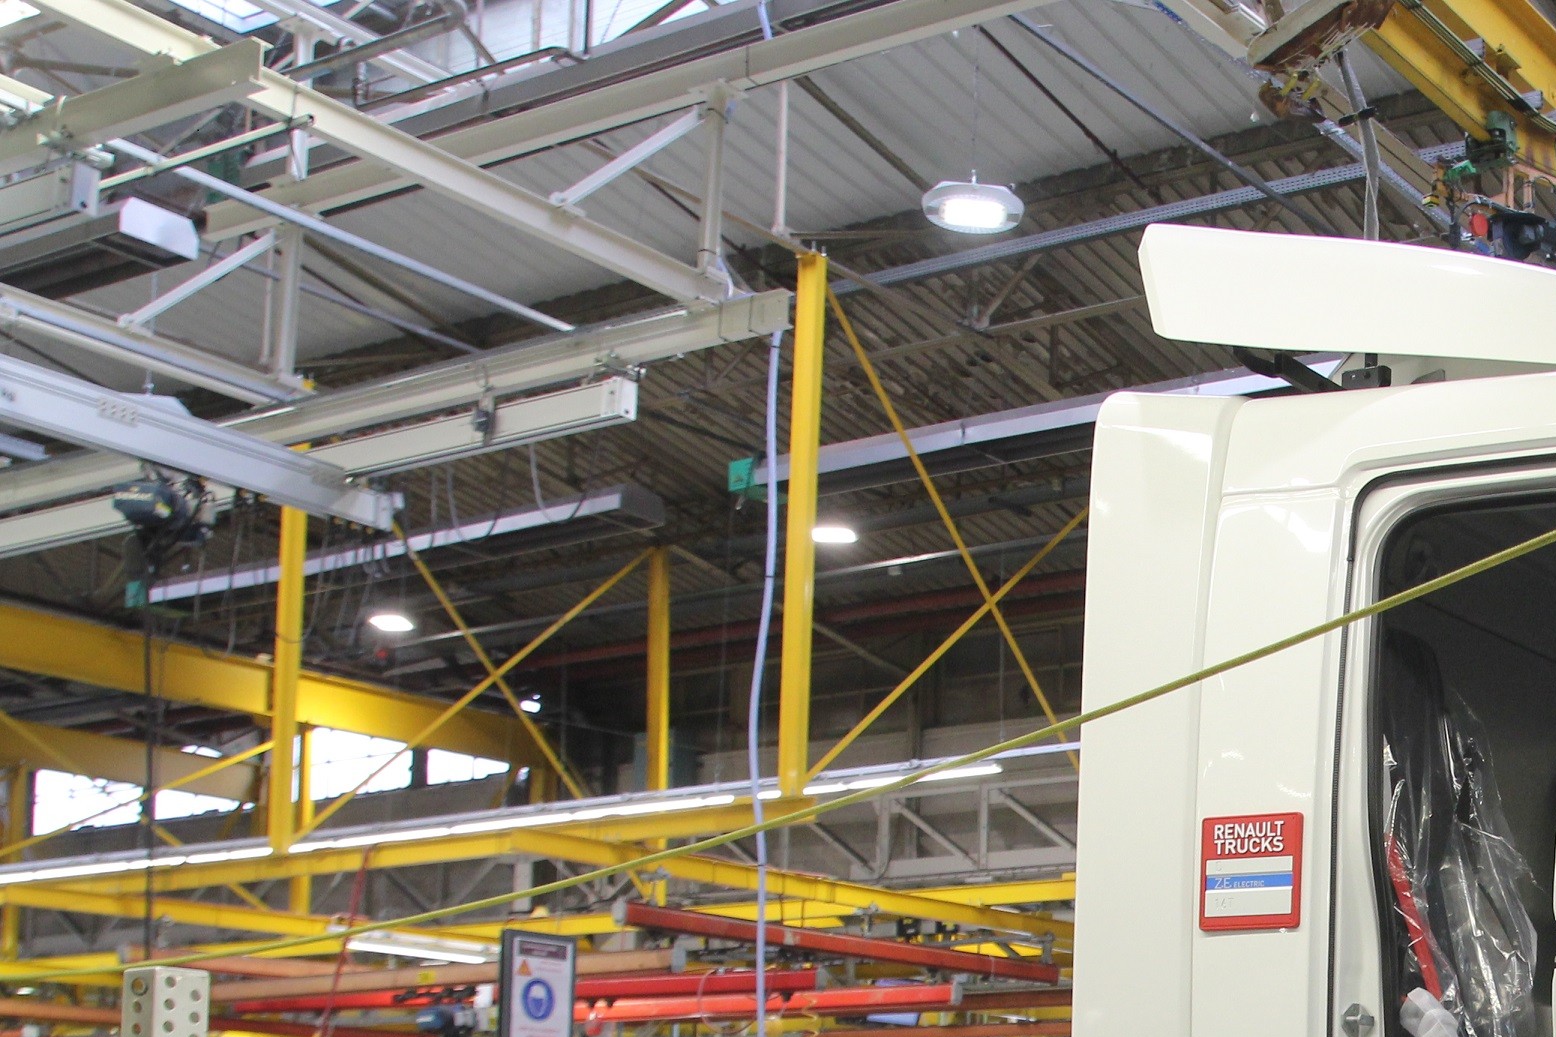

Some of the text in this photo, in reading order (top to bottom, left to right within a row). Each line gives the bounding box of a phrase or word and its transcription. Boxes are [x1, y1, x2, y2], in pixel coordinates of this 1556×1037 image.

[1213, 820, 1285, 840] RENAULT
[1213, 836, 1285, 855] TRUCKS
[1233, 880, 1265, 888] ELECTRIC
